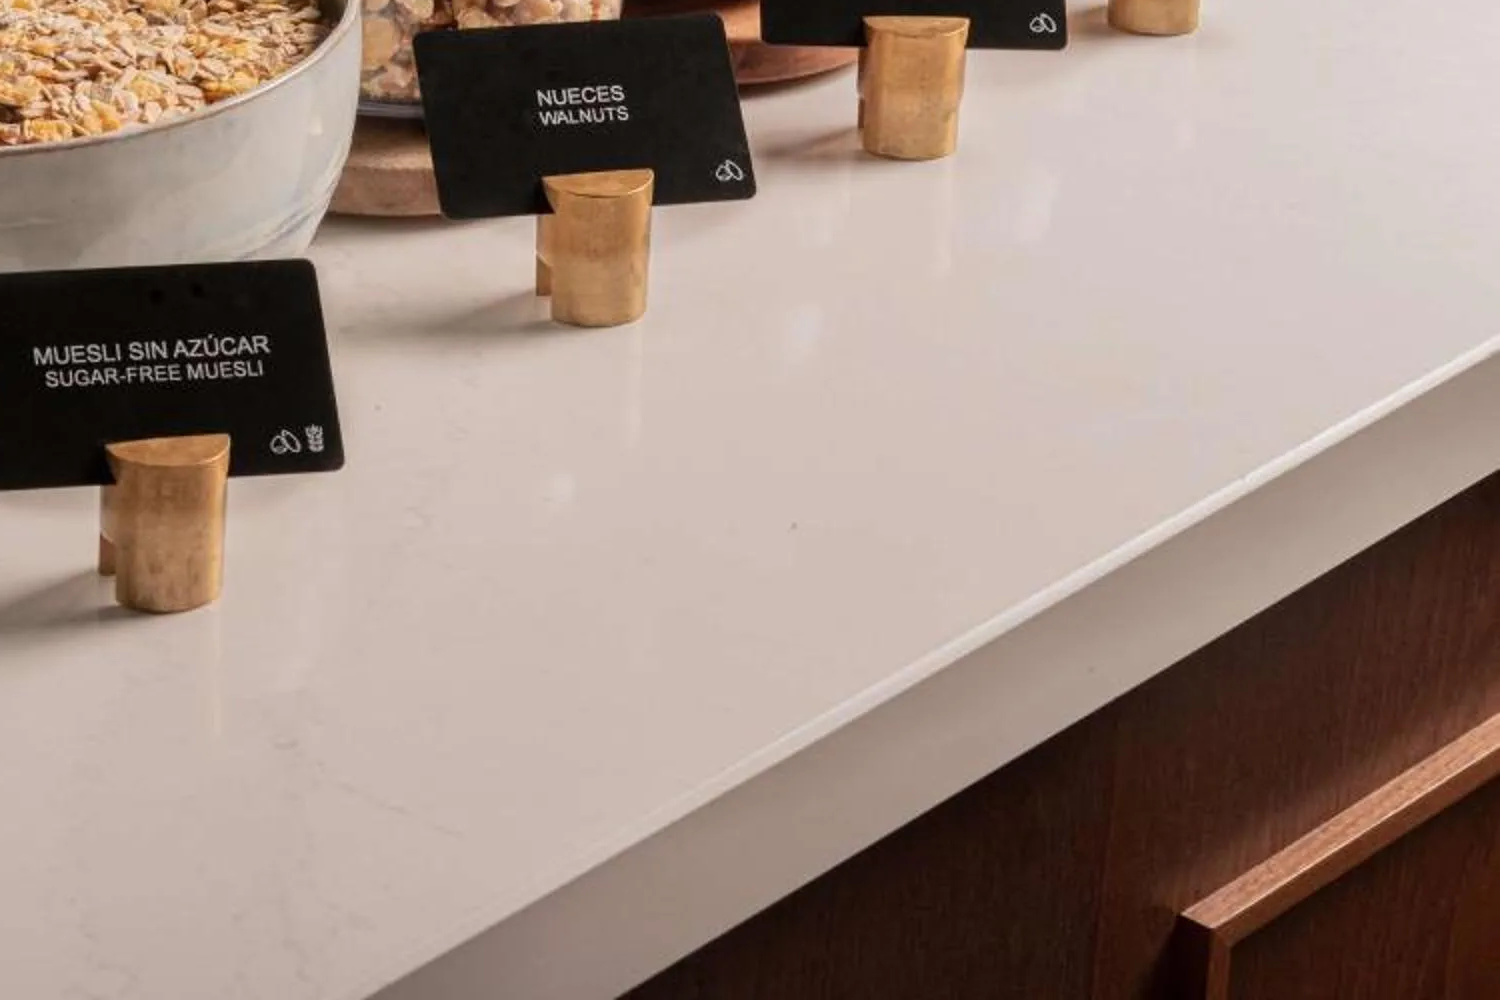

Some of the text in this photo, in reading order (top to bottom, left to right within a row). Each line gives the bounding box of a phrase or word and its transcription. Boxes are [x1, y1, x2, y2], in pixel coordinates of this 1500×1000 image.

[536, 85, 626, 106] NUECES
[538, 105, 630, 127] WALNUTS
[33, 333, 271, 367] MUESLI SIN AZÚCAR
[45, 359, 264, 389] SUGAR-FREE MUESLI
